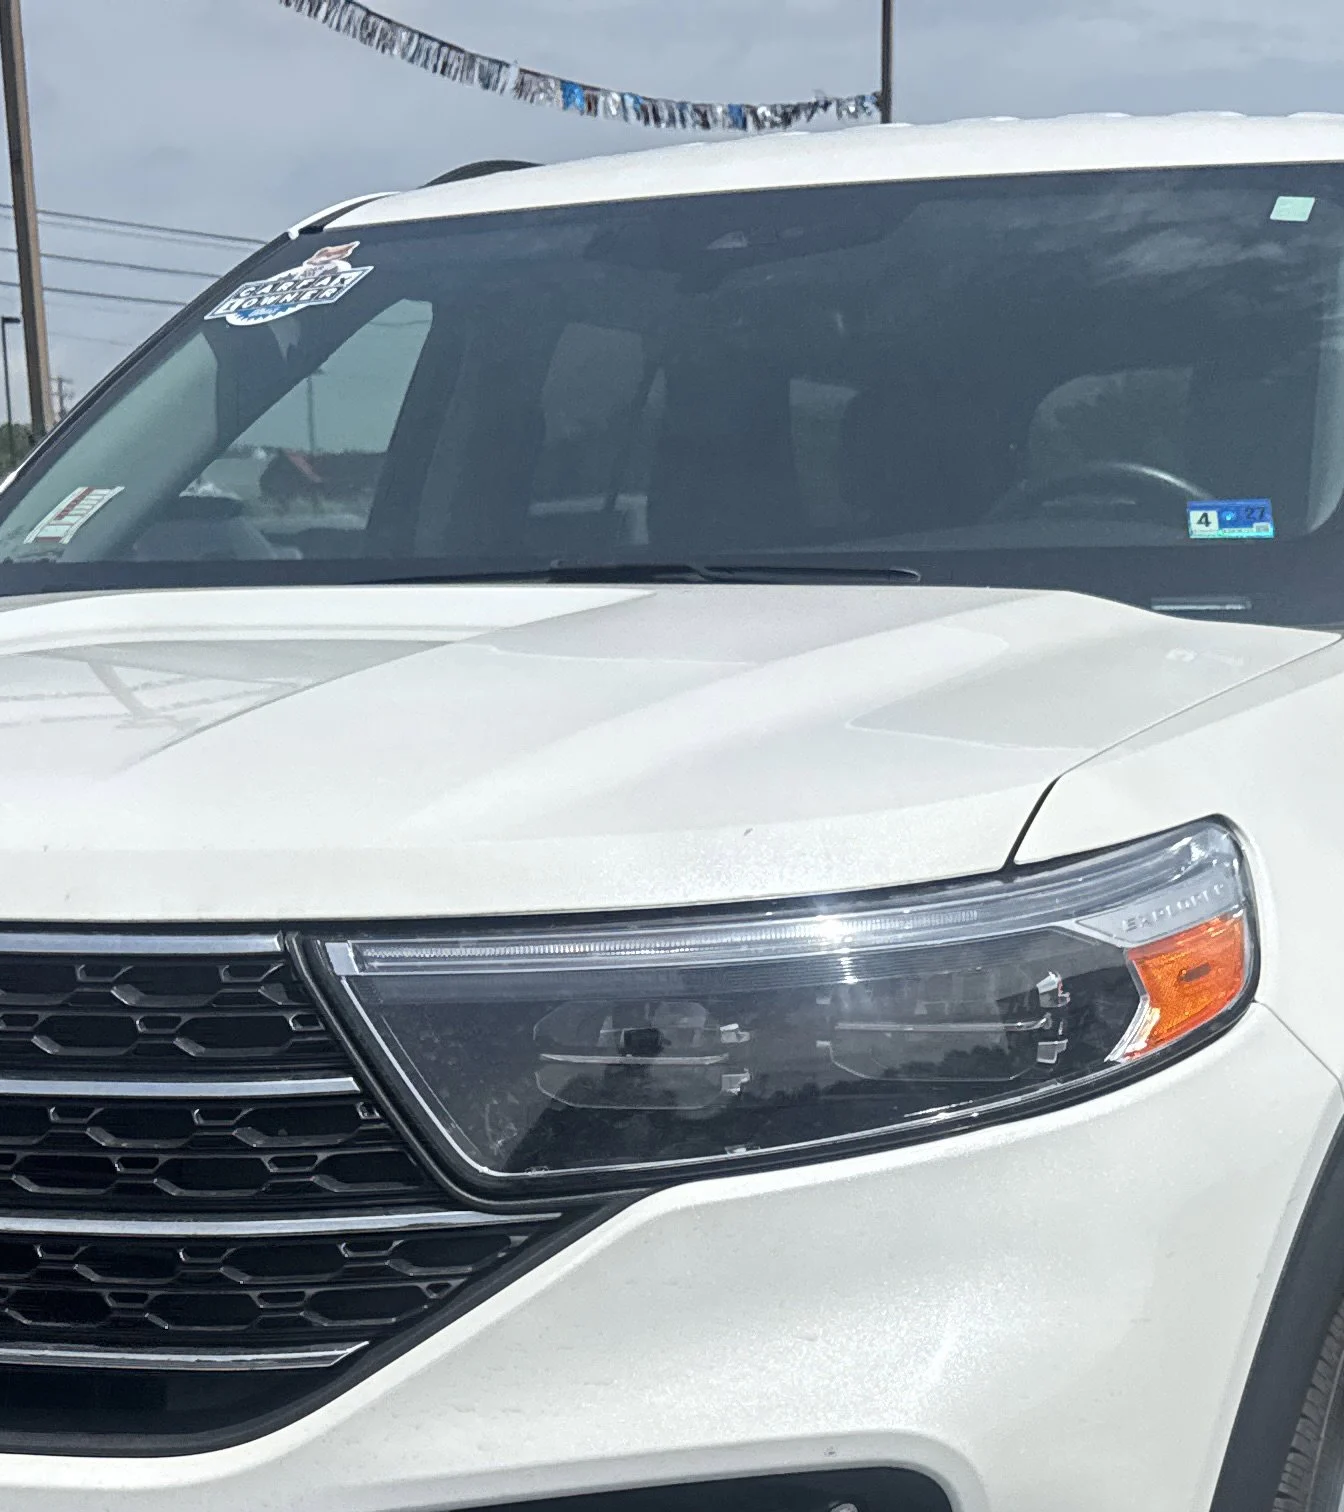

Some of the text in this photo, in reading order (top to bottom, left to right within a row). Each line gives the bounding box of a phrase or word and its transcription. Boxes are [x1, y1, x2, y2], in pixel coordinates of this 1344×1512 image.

[238, 271, 365, 298] CARFAX
[242, 287, 338, 309] OWNER
[1196, 506, 1265, 527] 4 27
